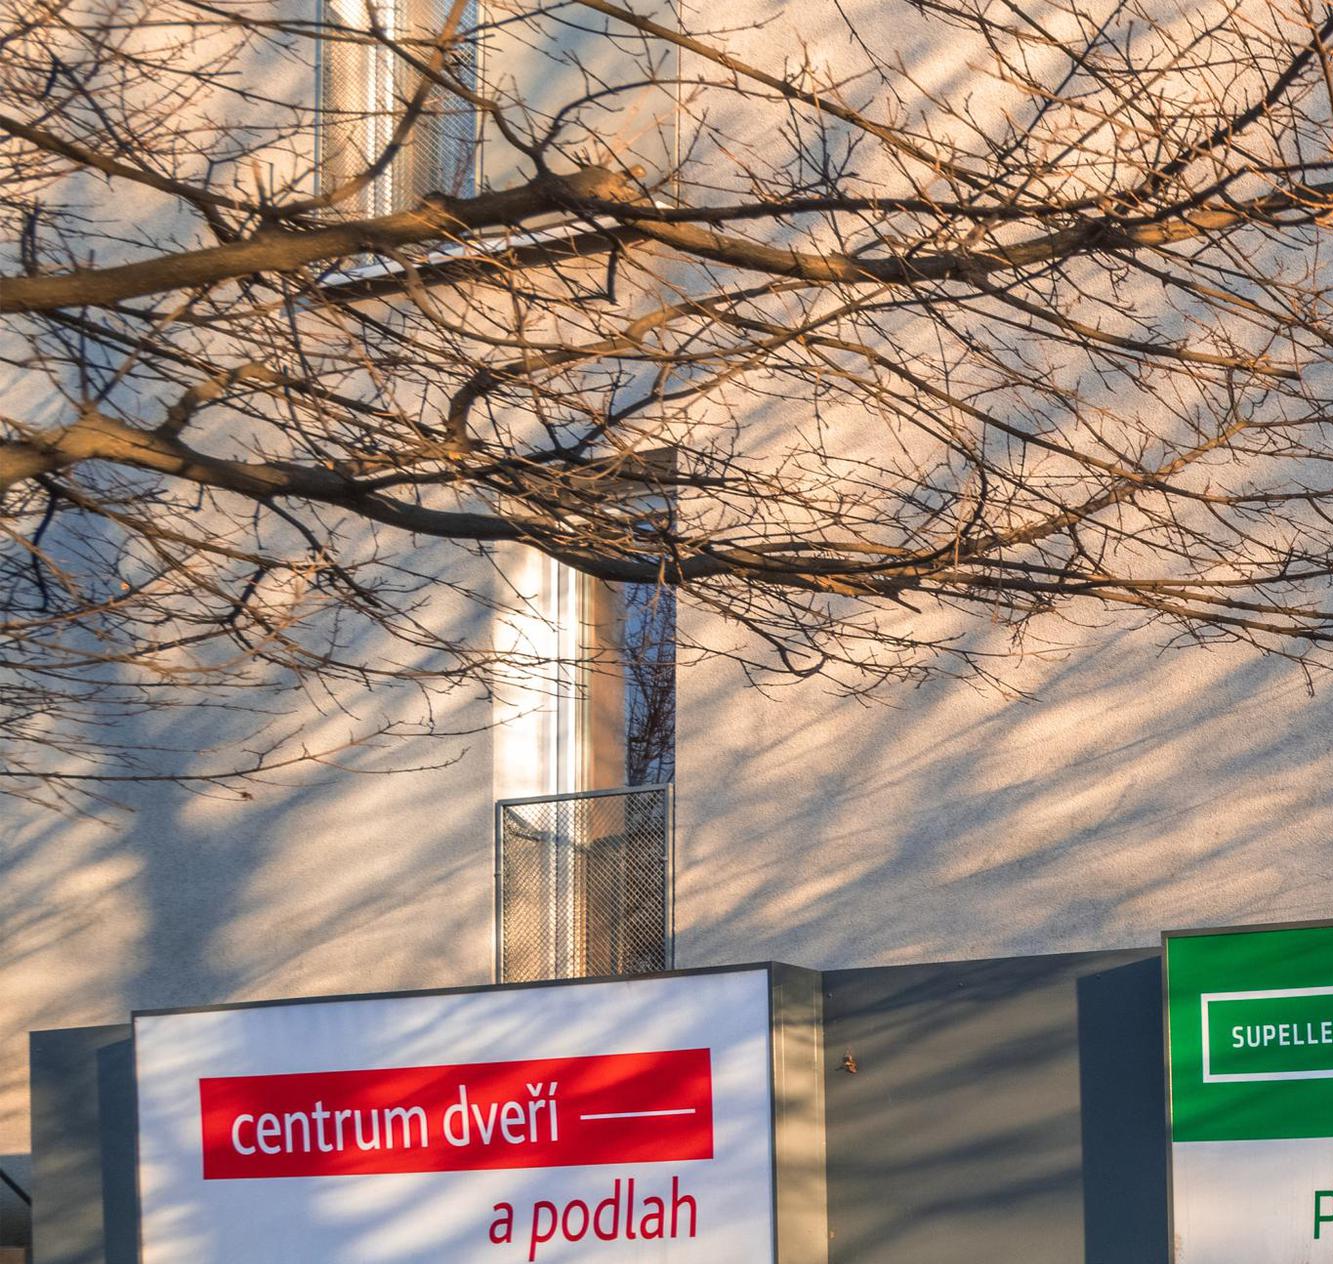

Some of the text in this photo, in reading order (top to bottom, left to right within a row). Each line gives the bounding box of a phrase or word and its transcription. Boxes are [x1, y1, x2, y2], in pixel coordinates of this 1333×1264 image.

[231, 1081, 558, 1155] centrum dveří
[489, 1175, 697, 1263] a podlah
